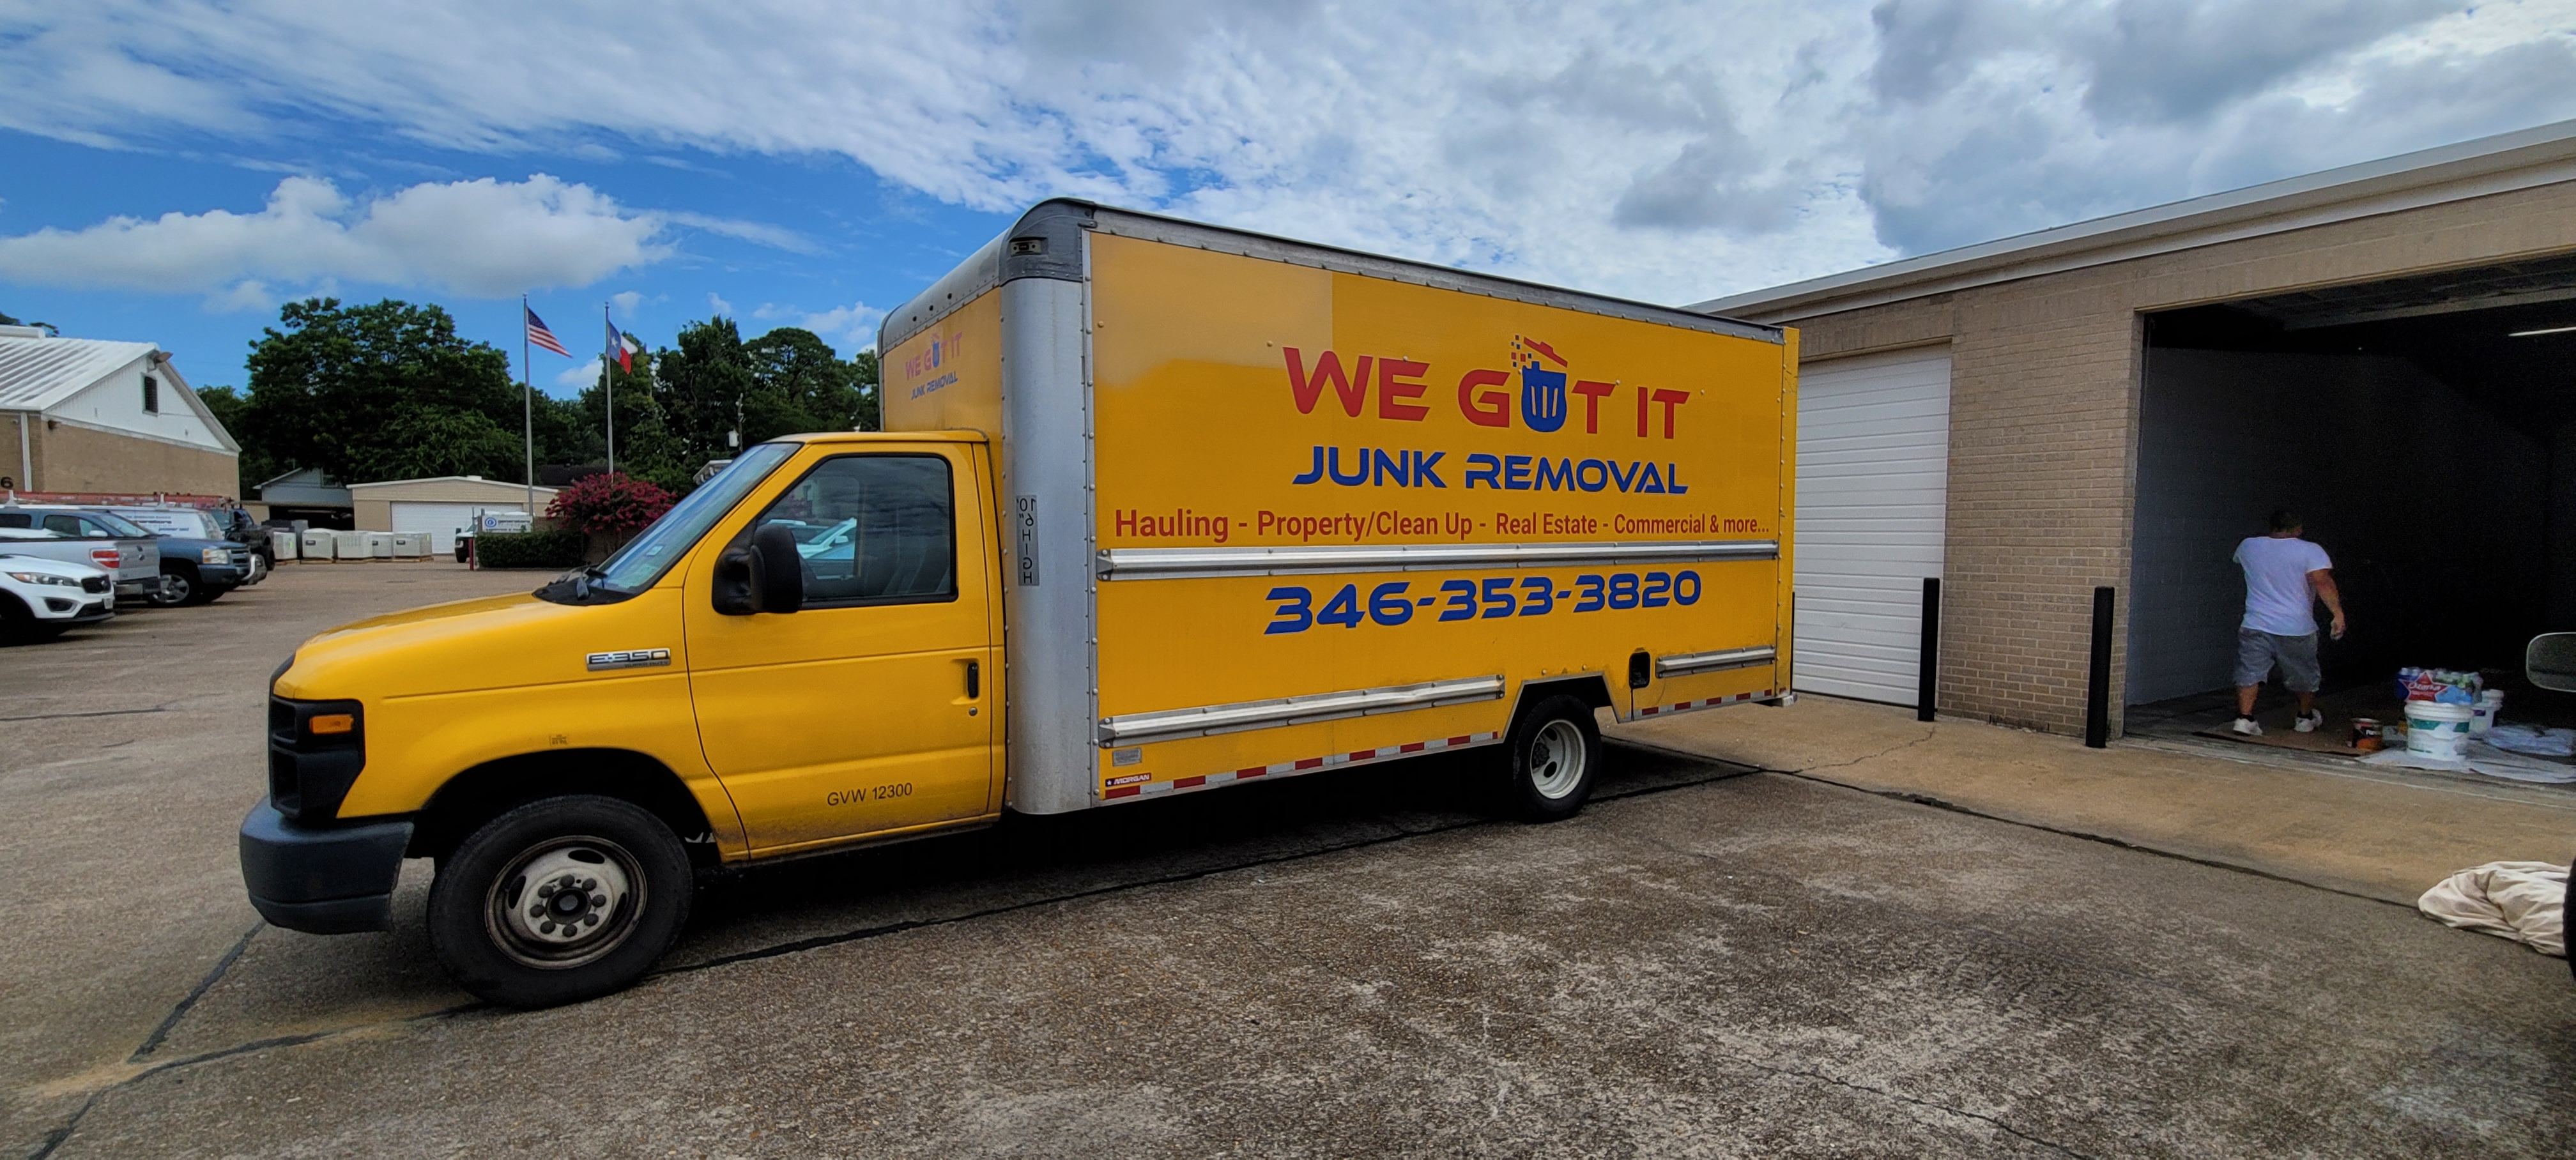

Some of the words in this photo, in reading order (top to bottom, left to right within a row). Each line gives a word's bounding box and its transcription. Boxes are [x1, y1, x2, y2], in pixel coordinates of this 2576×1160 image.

[905, 355, 921, 380] WE
[951, 332, 962, 358] IT
[911, 384, 925, 401] JUNK
[926, 370, 958, 393] REMOVAL
[1283, 347, 1430, 421] WE
[1637, 386, 1690, 439] IT
[1292, 445, 1446, 488] JUNK
[1465, 453, 1689, 494] REMOVAL
[1115, 508, 1229, 544] Hauling
[1257, 510, 1438, 542] Property/Clean
[1445, 512, 1473, 540] Up
[1496, 512, 1537, 535] Real
[1542, 513, 1597, 535] Estate
[1614, 513, 1706, 535] Commercial
[1709, 514, 1719, 534] &
[1723, 517, 1770, 533] more...
[1264, 570, 1701, 635] 346-353-3820
[827, 788, 866, 806] GVW
[872, 782, 913, 800] 12300
[1114, 774, 1150, 785] MORGAN
